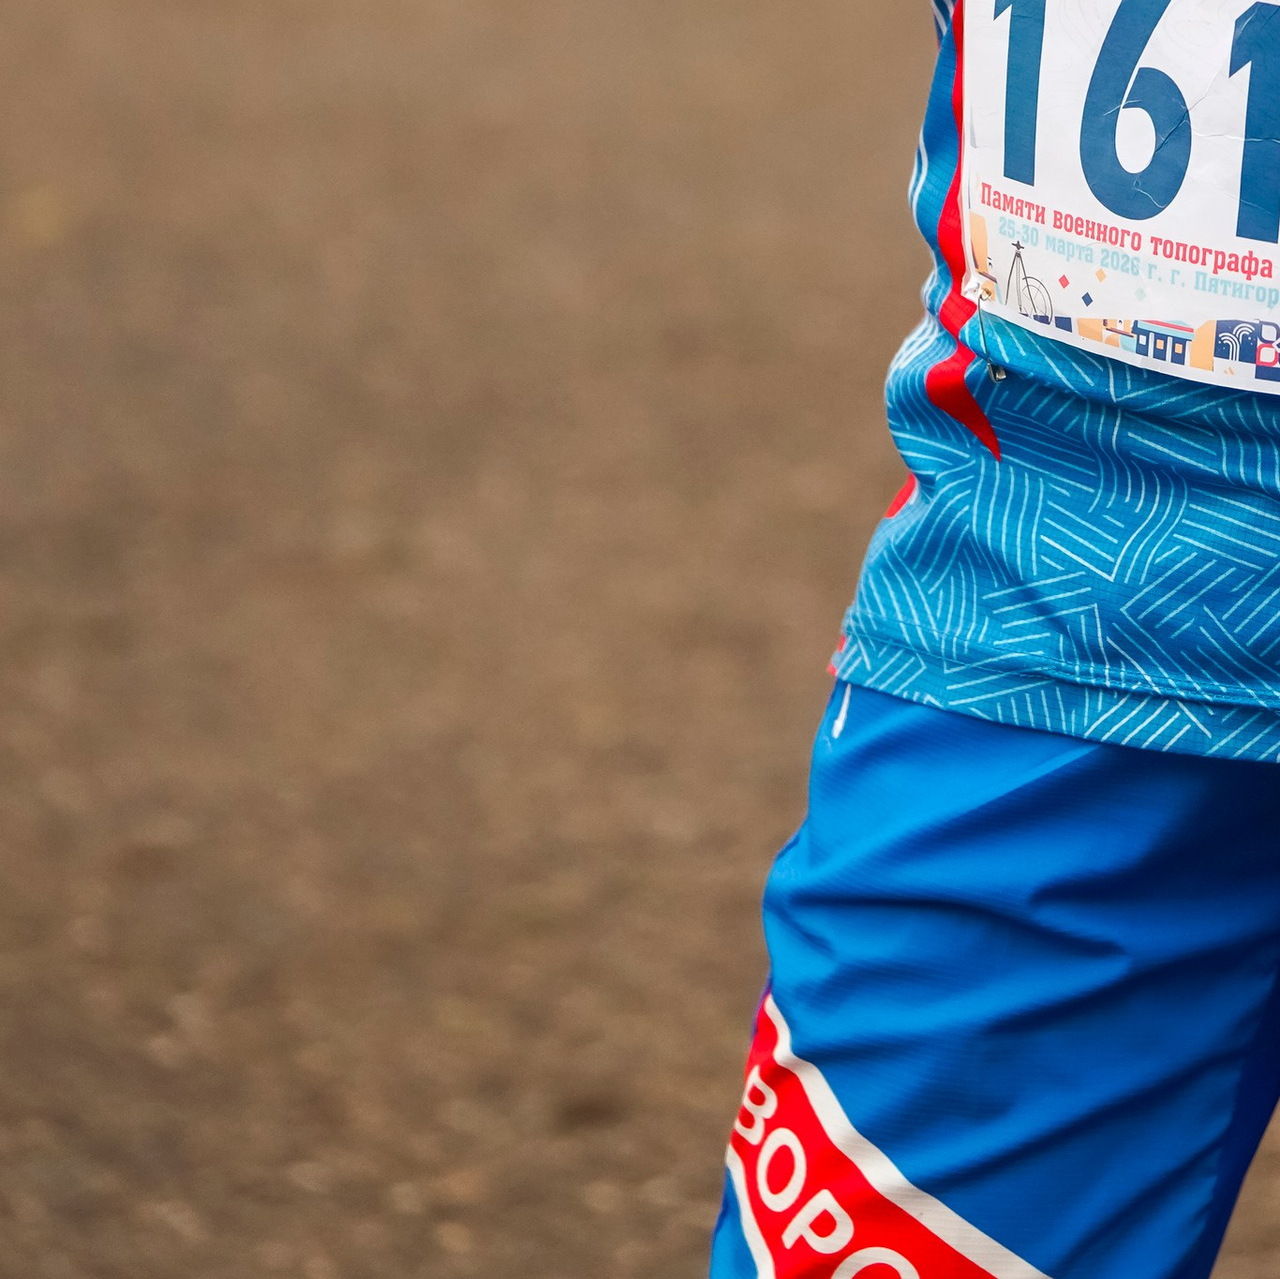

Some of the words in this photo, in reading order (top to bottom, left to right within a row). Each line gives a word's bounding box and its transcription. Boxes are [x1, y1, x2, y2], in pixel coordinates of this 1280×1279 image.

[981, 181, 1046, 225] Памяти
[1052, 210, 1142, 252] военного
[1150, 236, 1273, 281] топографа
[998, 216, 1039, 247] 25-30
[1045, 233, 1094, 264] марта
[1100, 248, 1140, 276] 2026
[1147, 263, 1162, 282] г.
[1170, 269, 1186, 288] г.
